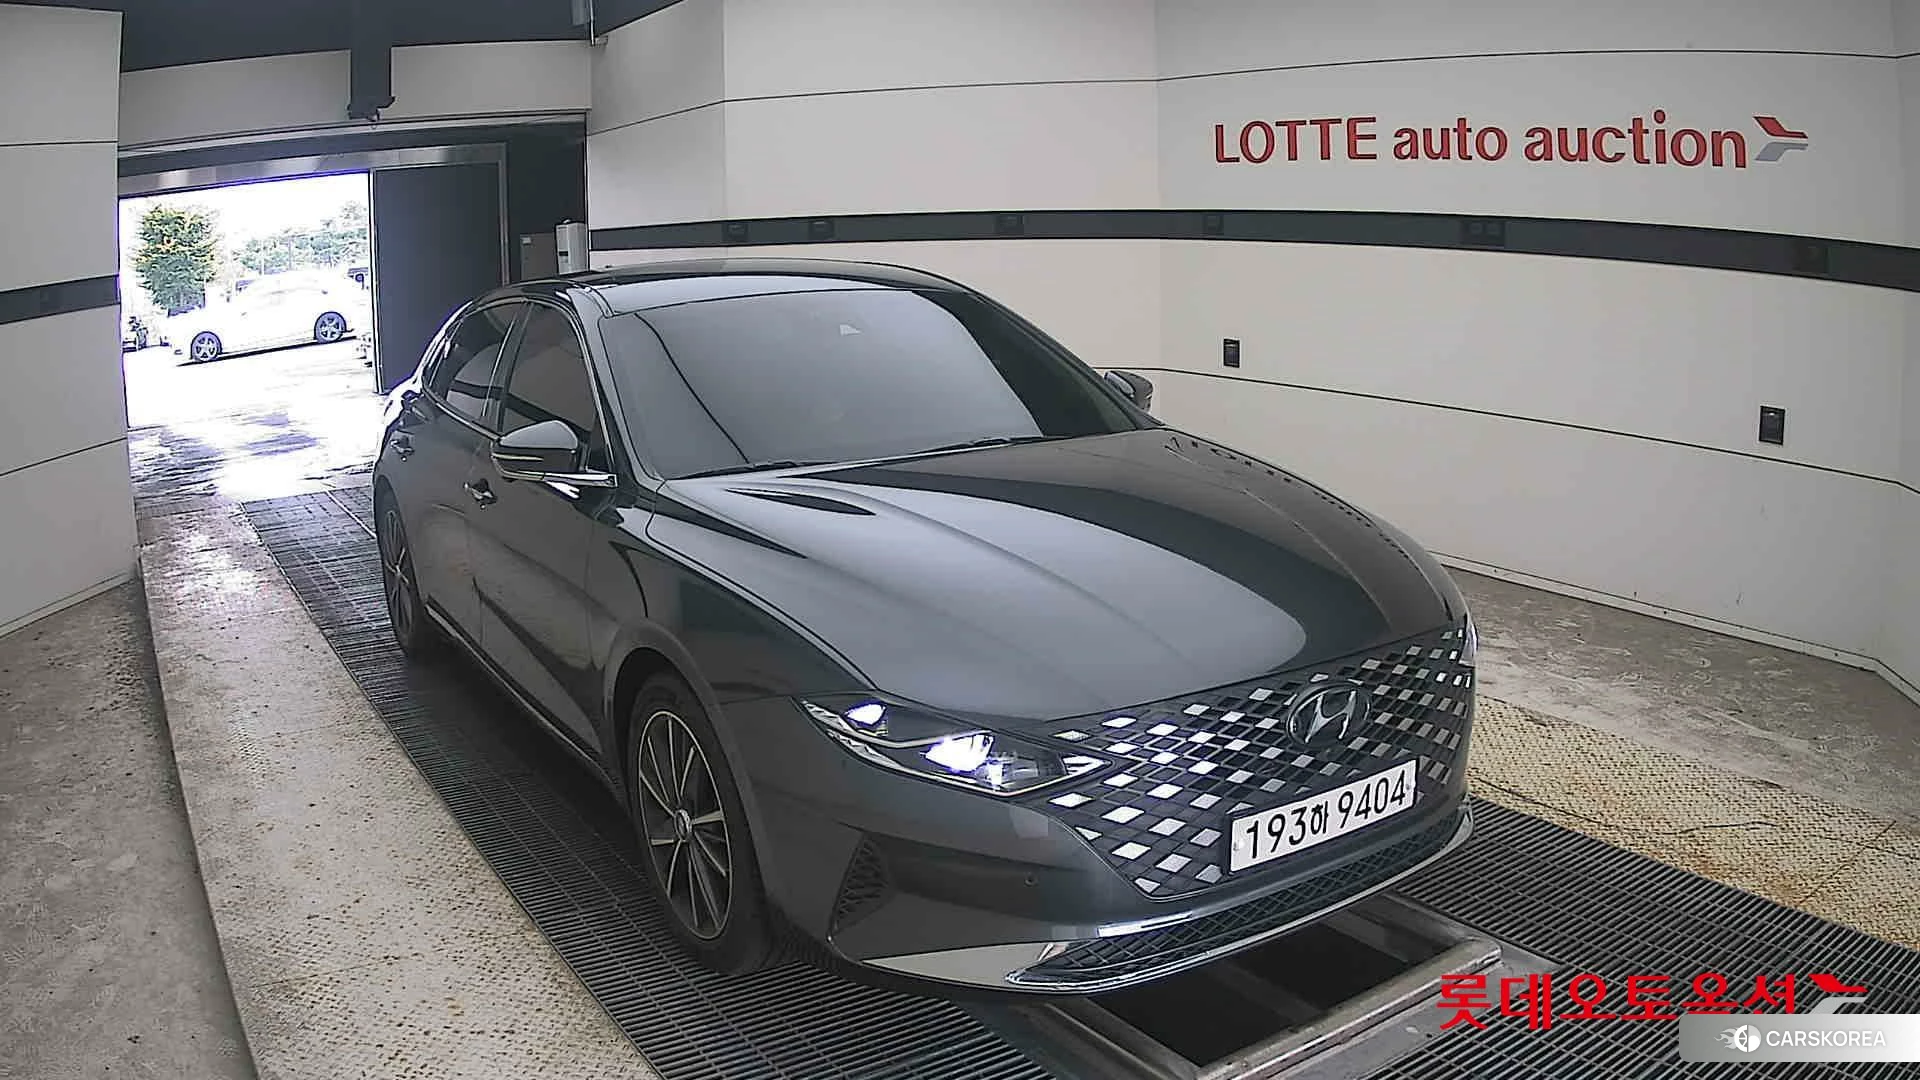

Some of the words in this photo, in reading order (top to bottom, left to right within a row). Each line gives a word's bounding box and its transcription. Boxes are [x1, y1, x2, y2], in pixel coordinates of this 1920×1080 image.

[1214, 116, 1377, 164] LOTTE
[1392, 117, 1510, 162] auto
[1523, 110, 1748, 168] auction
[1246, 801, 1329, 859] 193하
[1338, 769, 1406, 829] 9404
